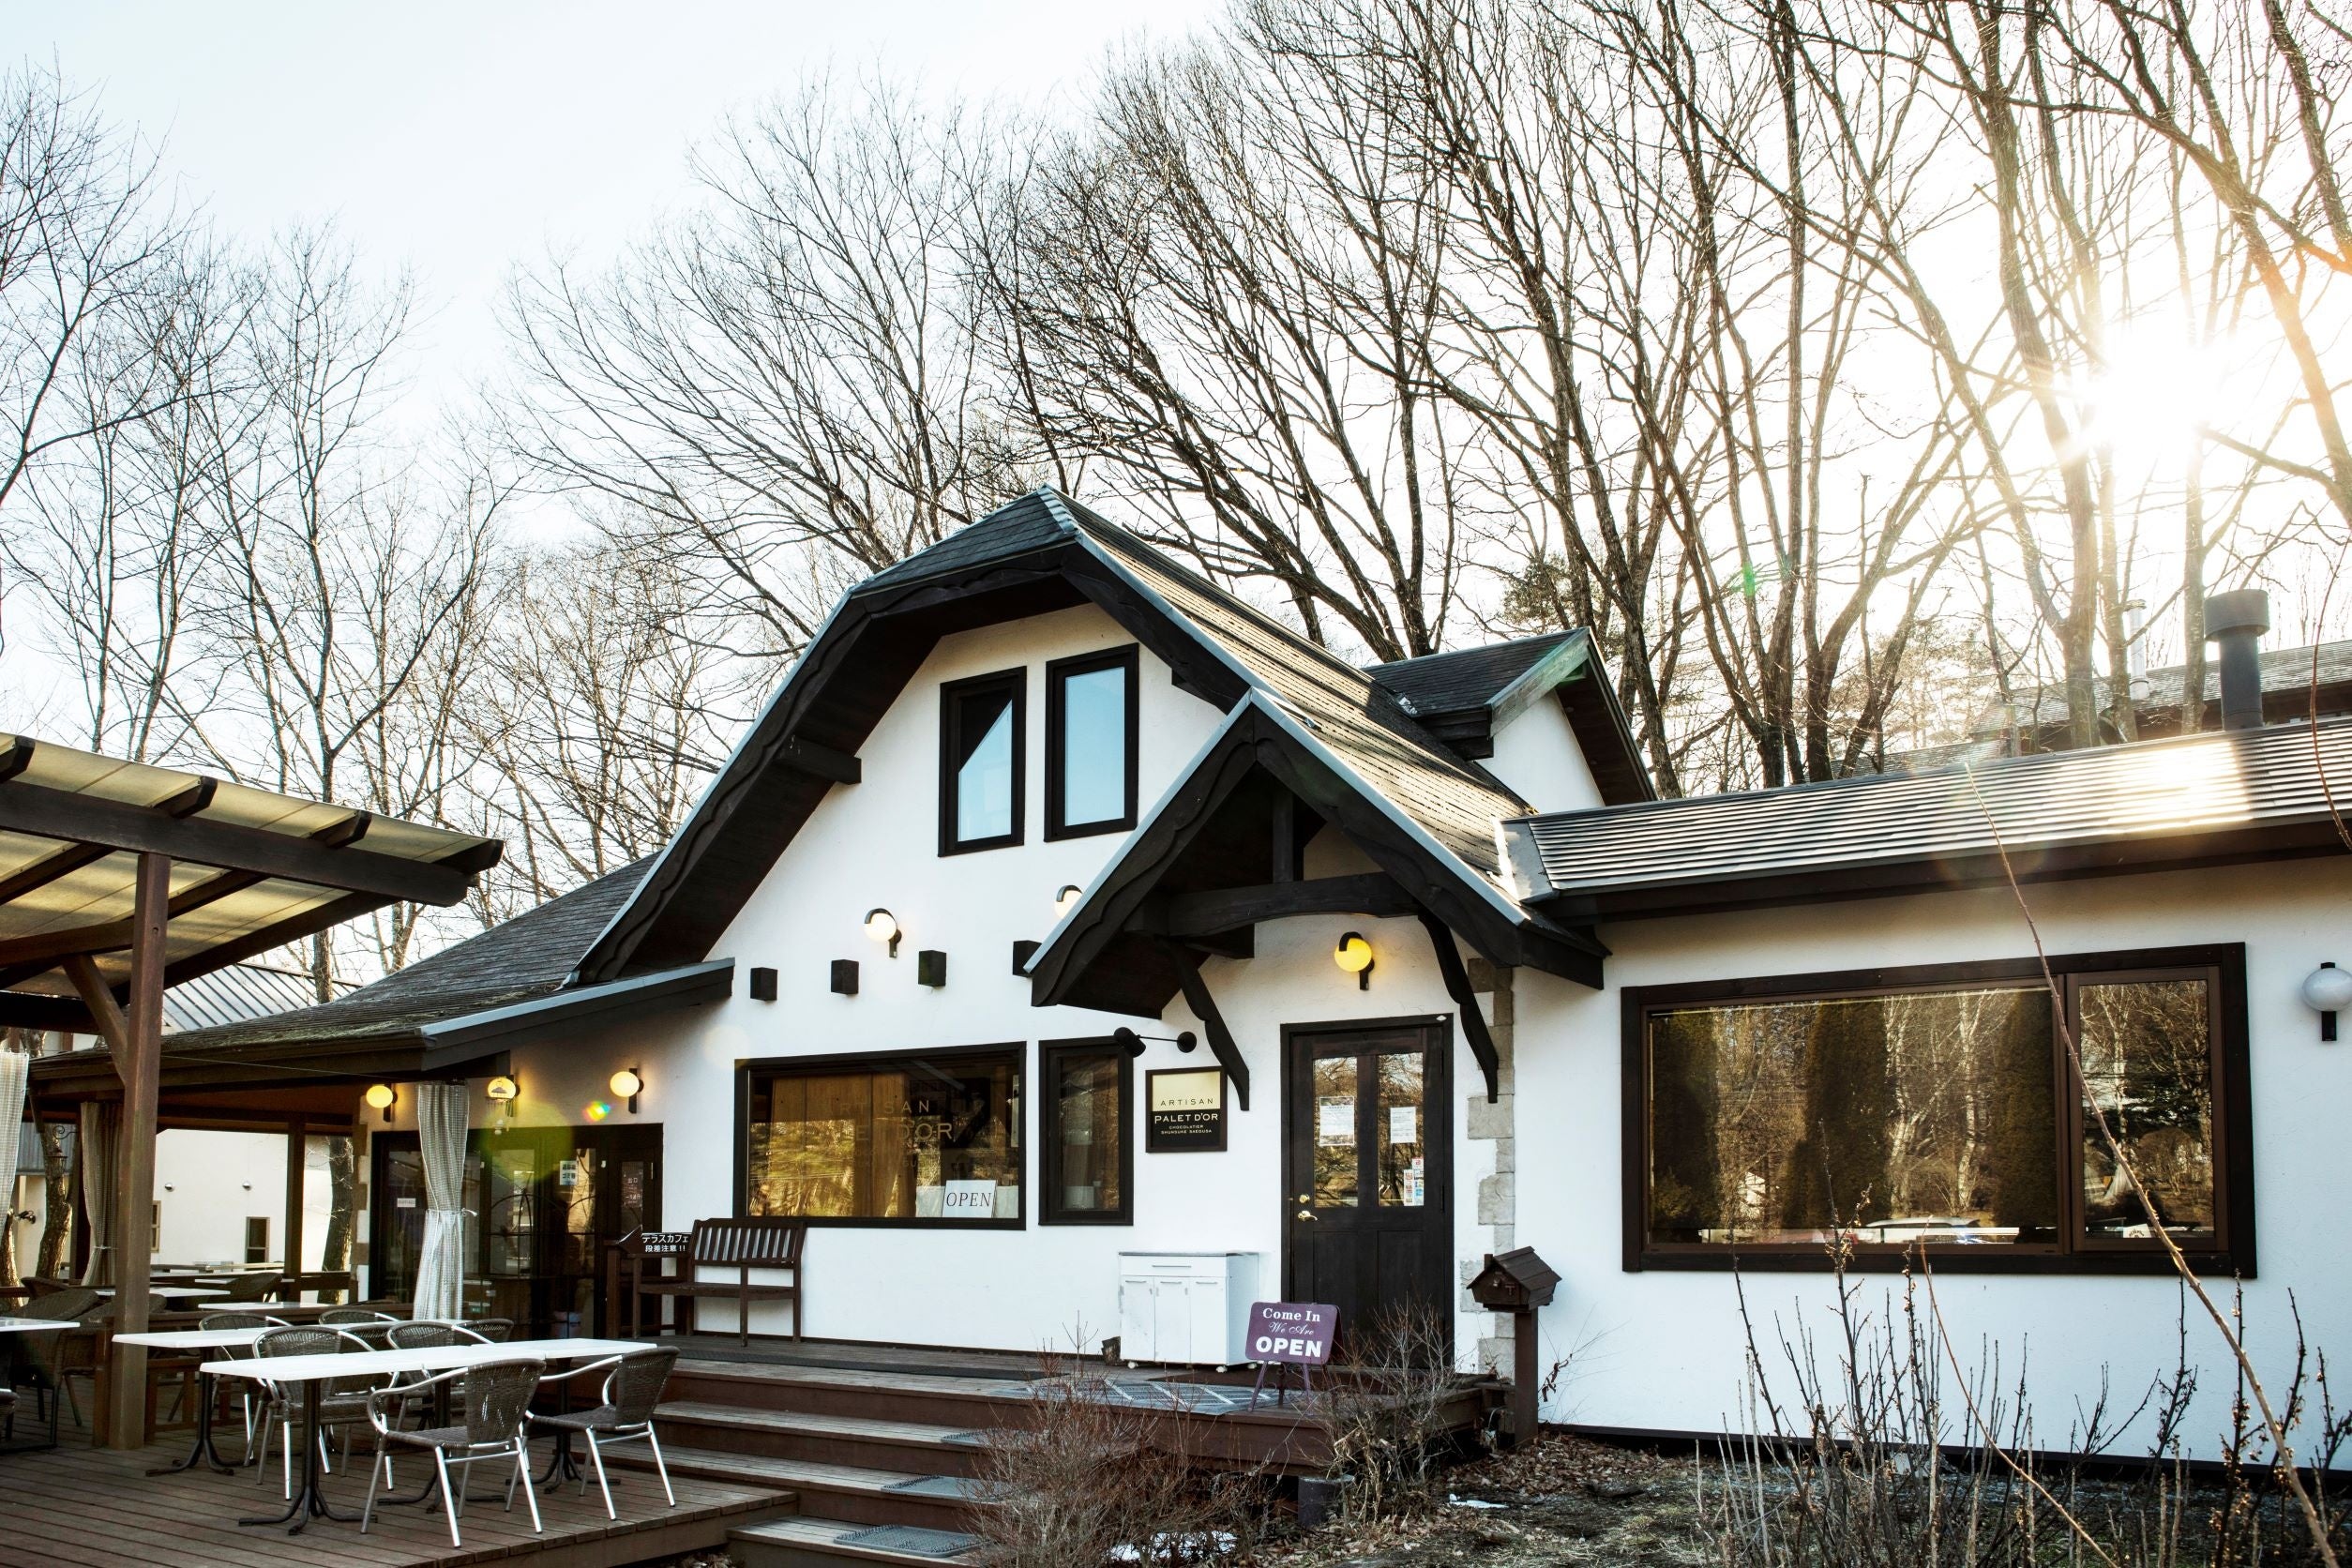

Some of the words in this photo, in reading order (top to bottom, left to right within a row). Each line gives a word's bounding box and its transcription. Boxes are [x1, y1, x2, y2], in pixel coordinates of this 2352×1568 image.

[1160, 1098, 1214, 1107] ARTISAN
[1154, 1114, 1191, 1124] PALET
[1194, 1113, 1218, 1122] D'OR
[946, 1192, 992, 1207] OPEN
[641, 1234, 689, 1244] テラスカフェ
[1262, 1307, 1302, 1321] Come
[1305, 1310, 1321, 1322] In
[1268, 1321, 1287, 1334] We
[1289, 1323, 1315, 1335] Are
[1256, 1335, 1322, 1358] OPEN
